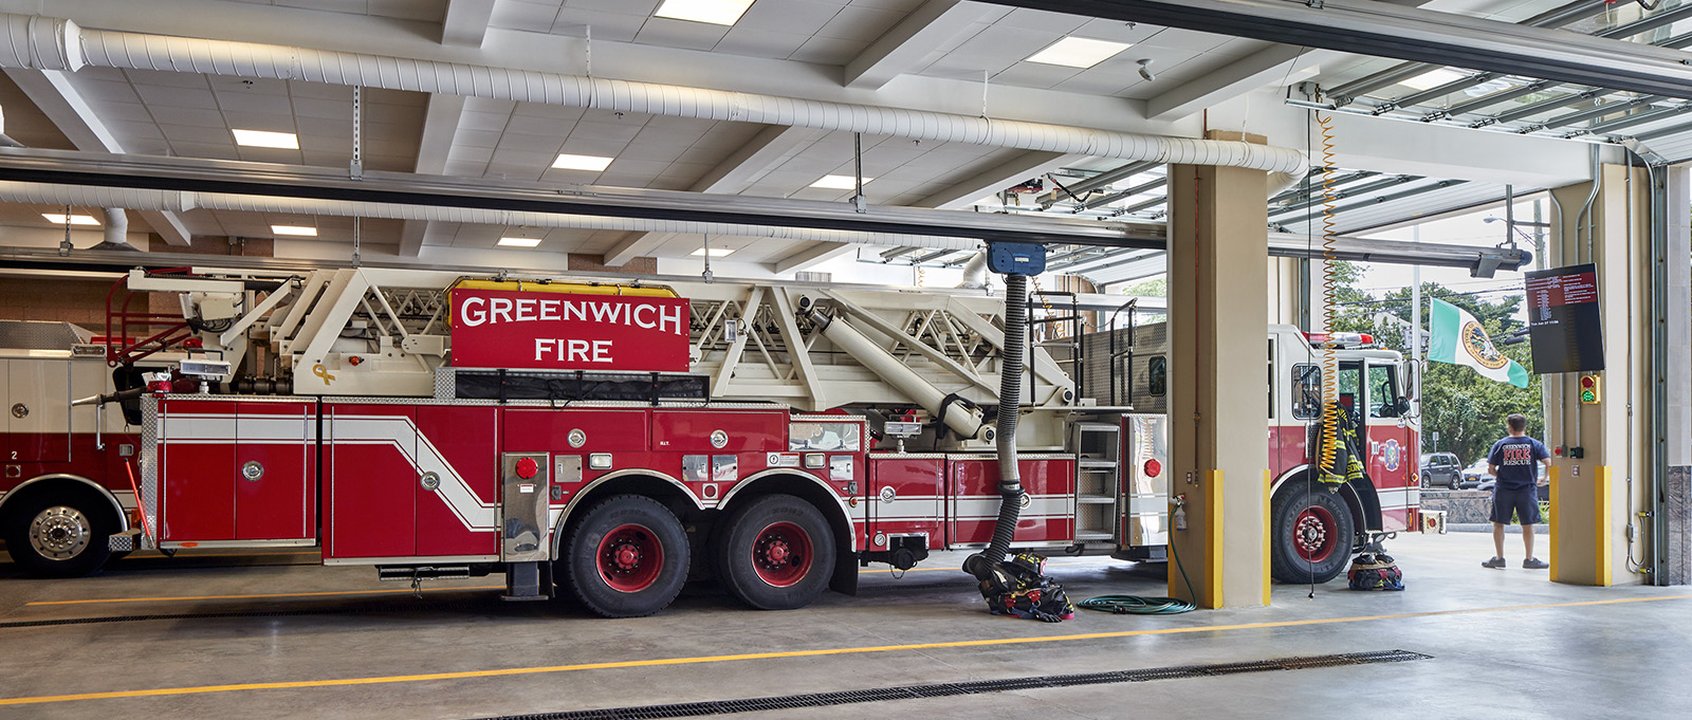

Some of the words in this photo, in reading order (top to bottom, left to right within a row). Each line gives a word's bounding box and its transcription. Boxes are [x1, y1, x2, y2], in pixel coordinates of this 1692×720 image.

[461, 296, 682, 336] GREENWICH
[534, 338, 613, 363] FIRE
[11, 450, 18, 460] 2
[1503, 448, 1531, 461] FIRE
